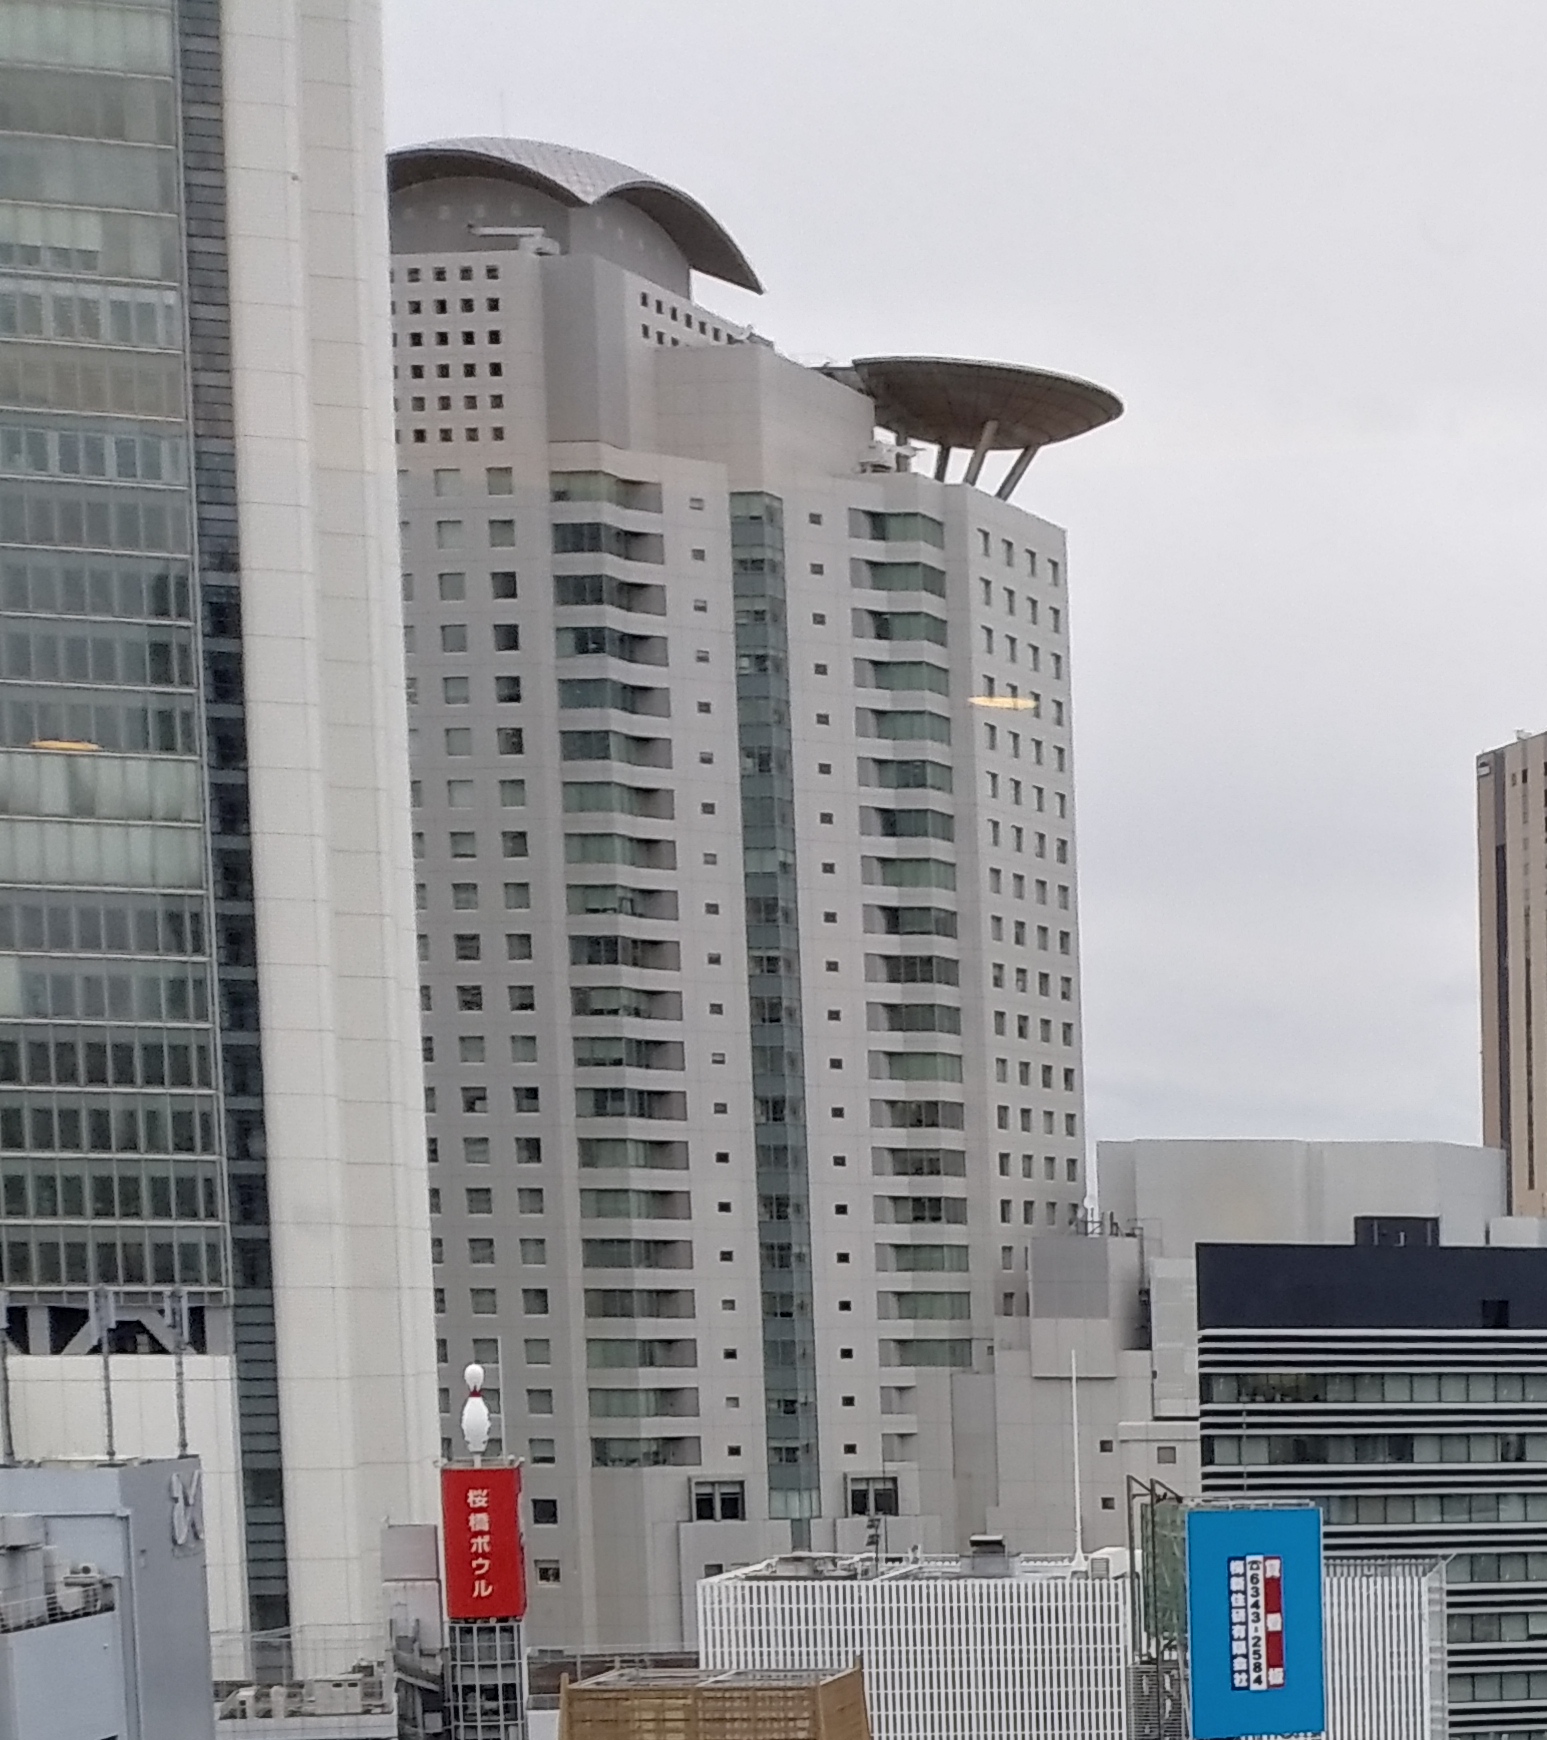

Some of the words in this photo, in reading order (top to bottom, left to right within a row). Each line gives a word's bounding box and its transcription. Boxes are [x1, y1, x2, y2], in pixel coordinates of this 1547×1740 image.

[466, 1488, 493, 1598] 桜橋ボウル
